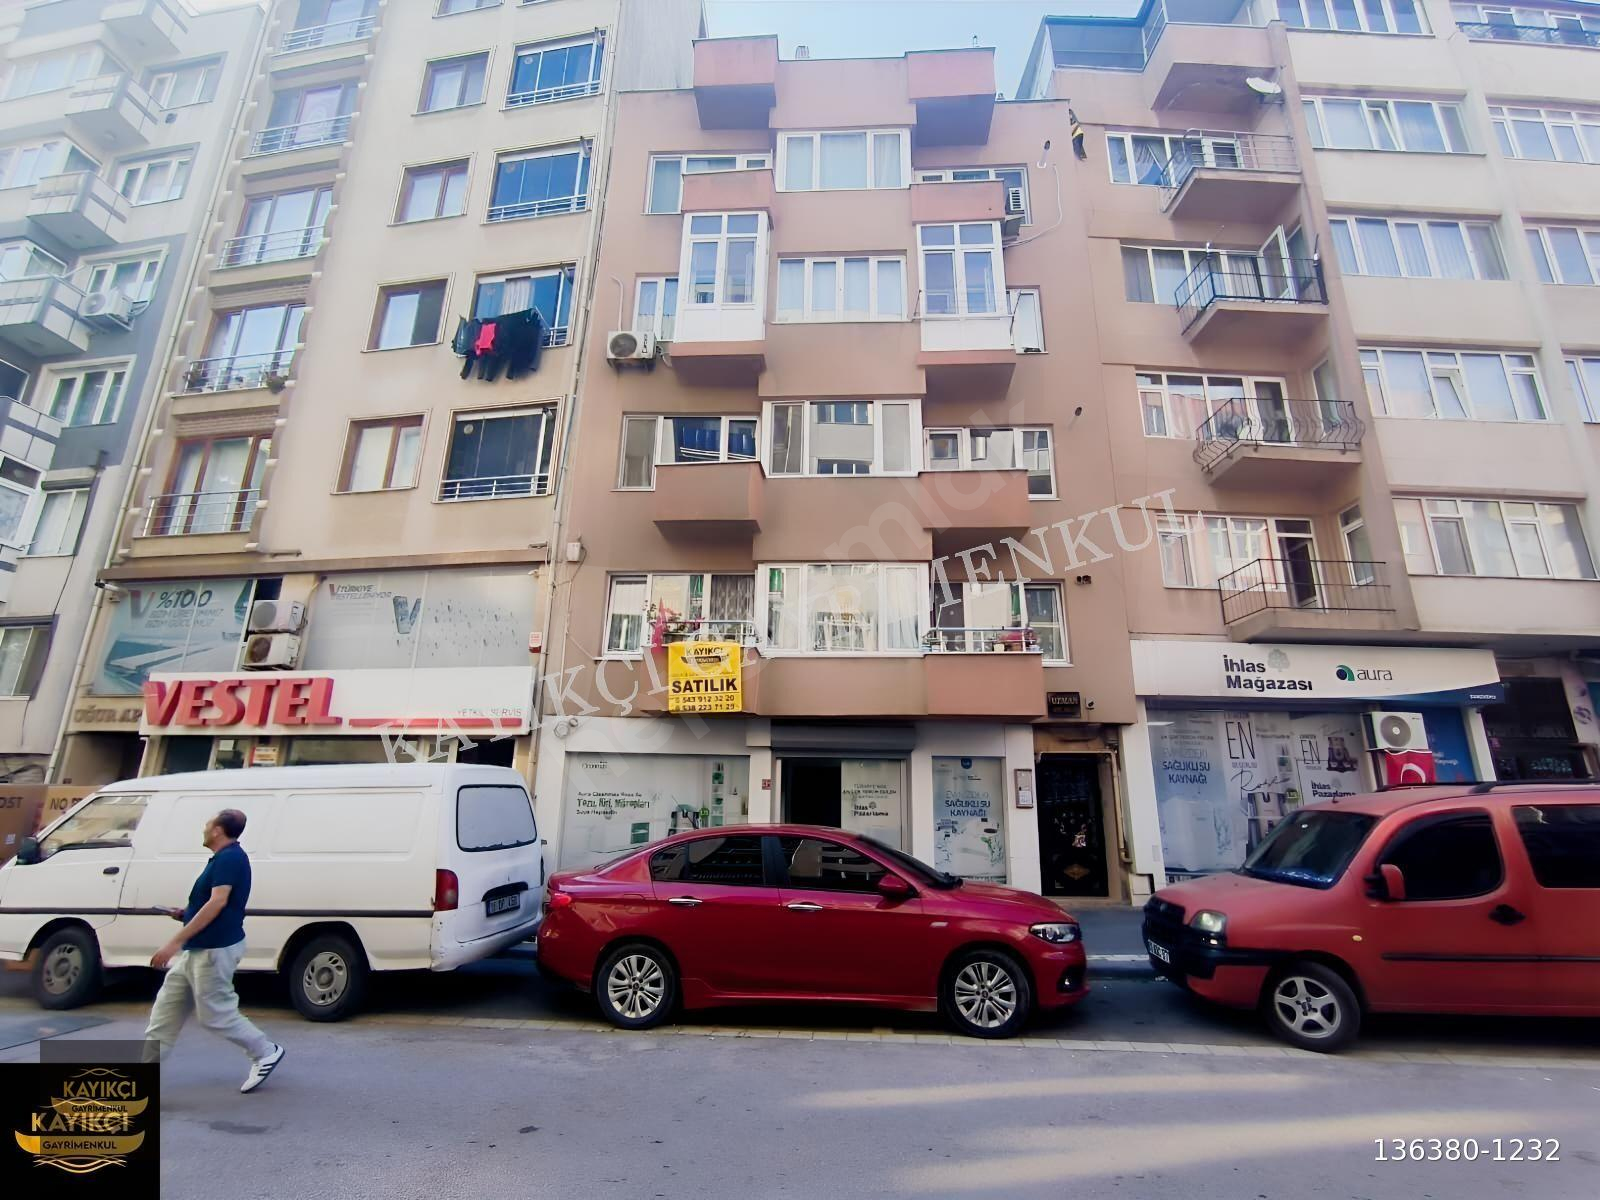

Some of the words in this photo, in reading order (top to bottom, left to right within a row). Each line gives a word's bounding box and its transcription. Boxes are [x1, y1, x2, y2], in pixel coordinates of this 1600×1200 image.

[157, 589, 213, 609] %100
[1223, 654, 1267, 674] İhlas
[1357, 667, 1393, 681] aura
[671, 678, 738, 694] SATILIK
[1226, 675, 1313, 693] Mağazası
[143, 677, 343, 729] VESTEL
[725, 694, 735, 702] 20
[1225, 720, 1257, 760] EN
[1300, 739, 1321, 765] EN
[1168, 772, 1208, 784] KAYNAĞI
[0, 796, 24, 809] OST
